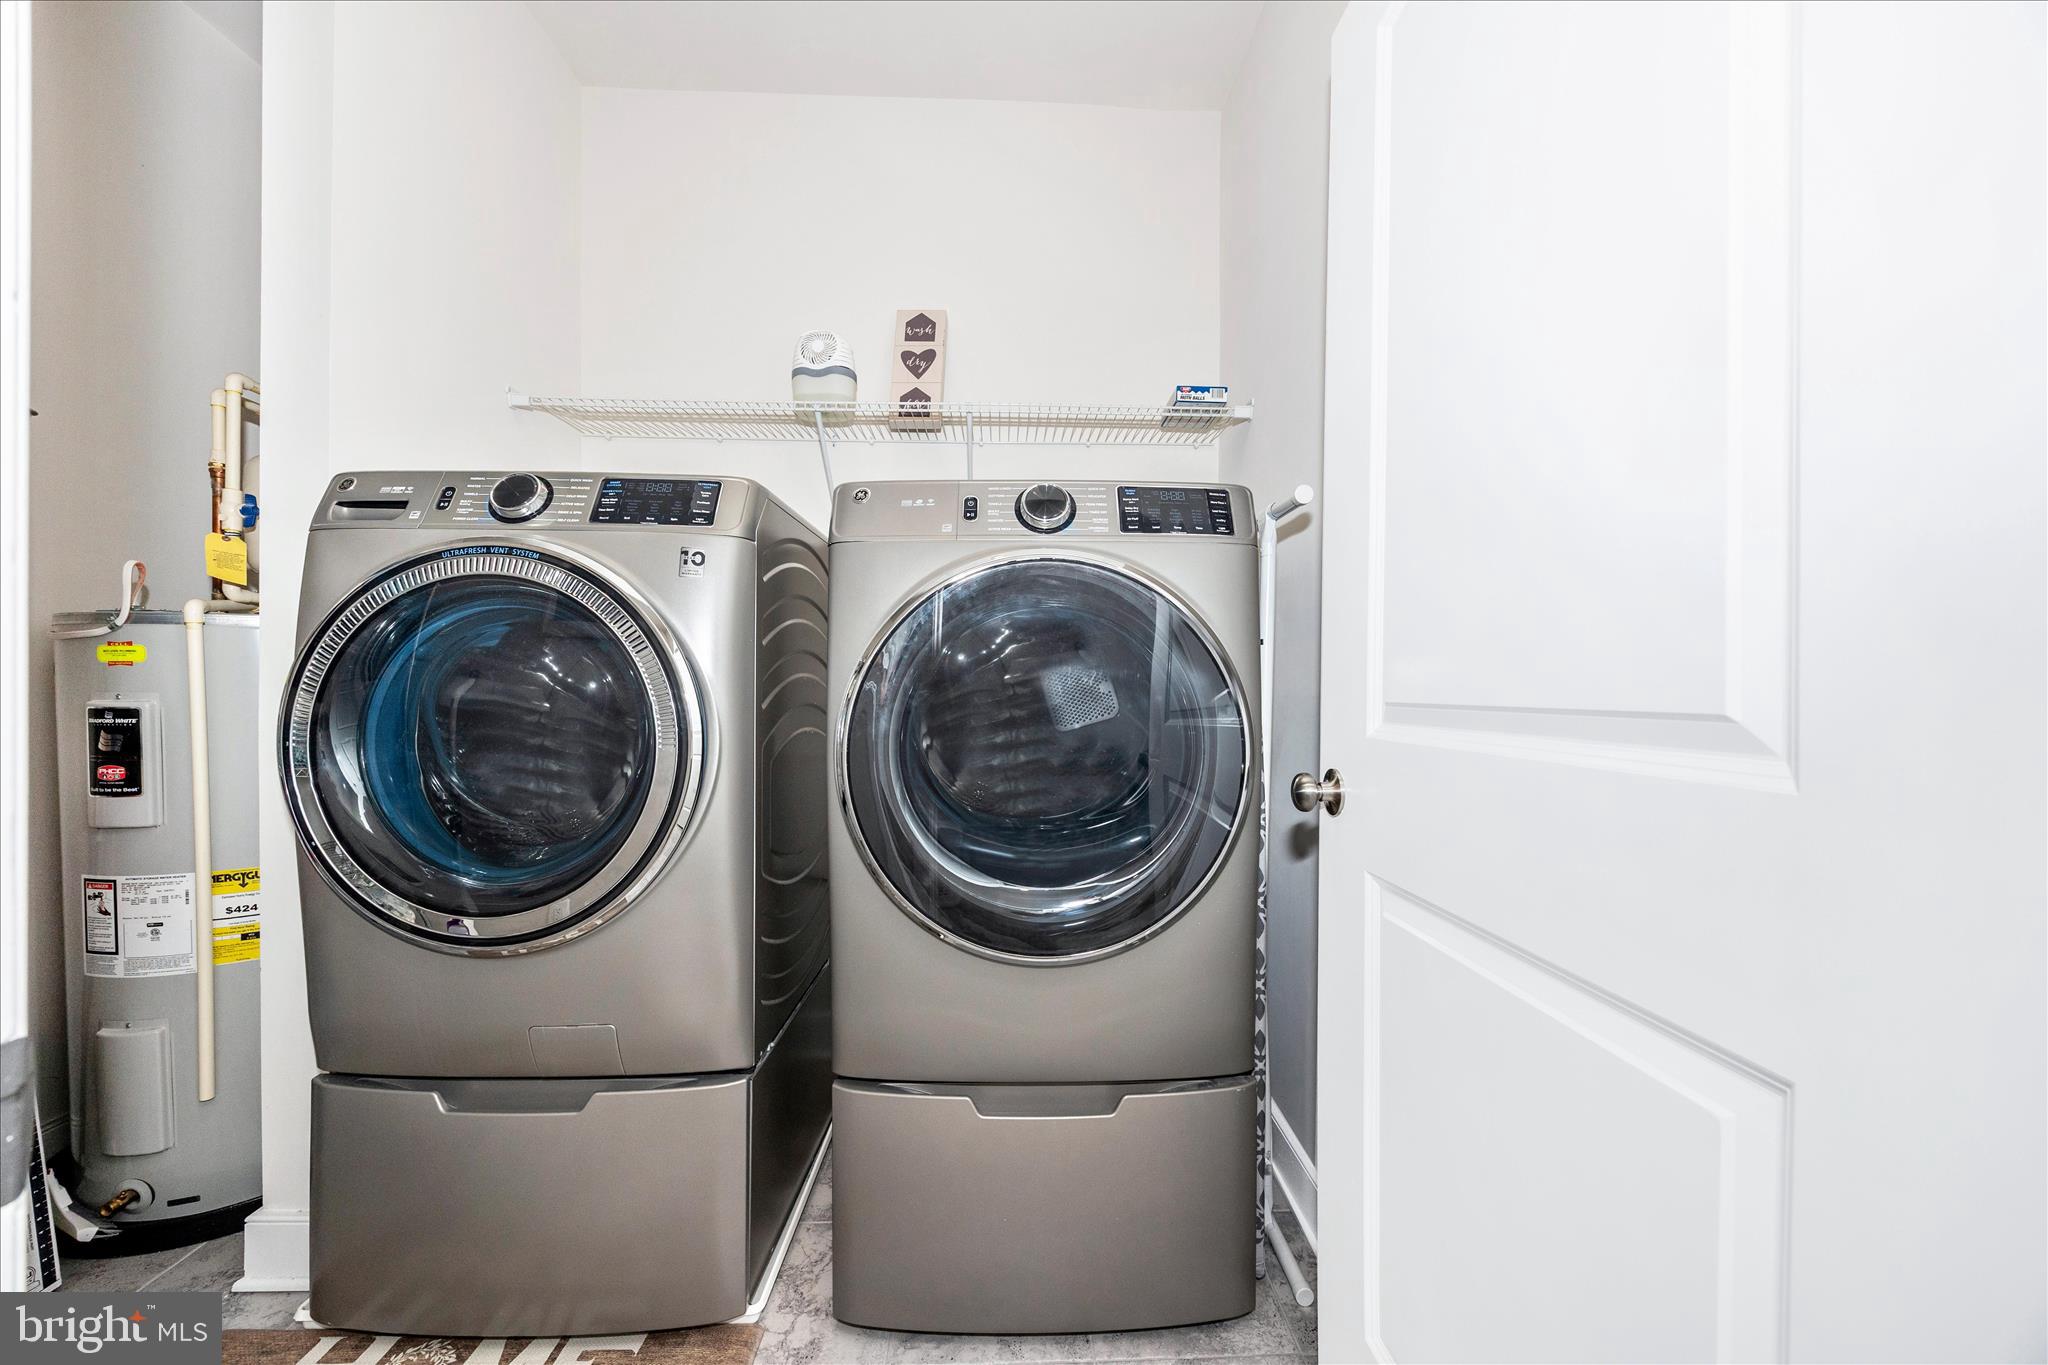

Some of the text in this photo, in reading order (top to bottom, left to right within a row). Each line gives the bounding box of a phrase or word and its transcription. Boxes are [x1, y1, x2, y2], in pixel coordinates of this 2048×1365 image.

[905, 323, 935, 336] wash
[906, 356, 930, 373] dry
[441, 547, 487, 558] ULTRAFRESH
[512, 548, 540, 559] SYSTEM
